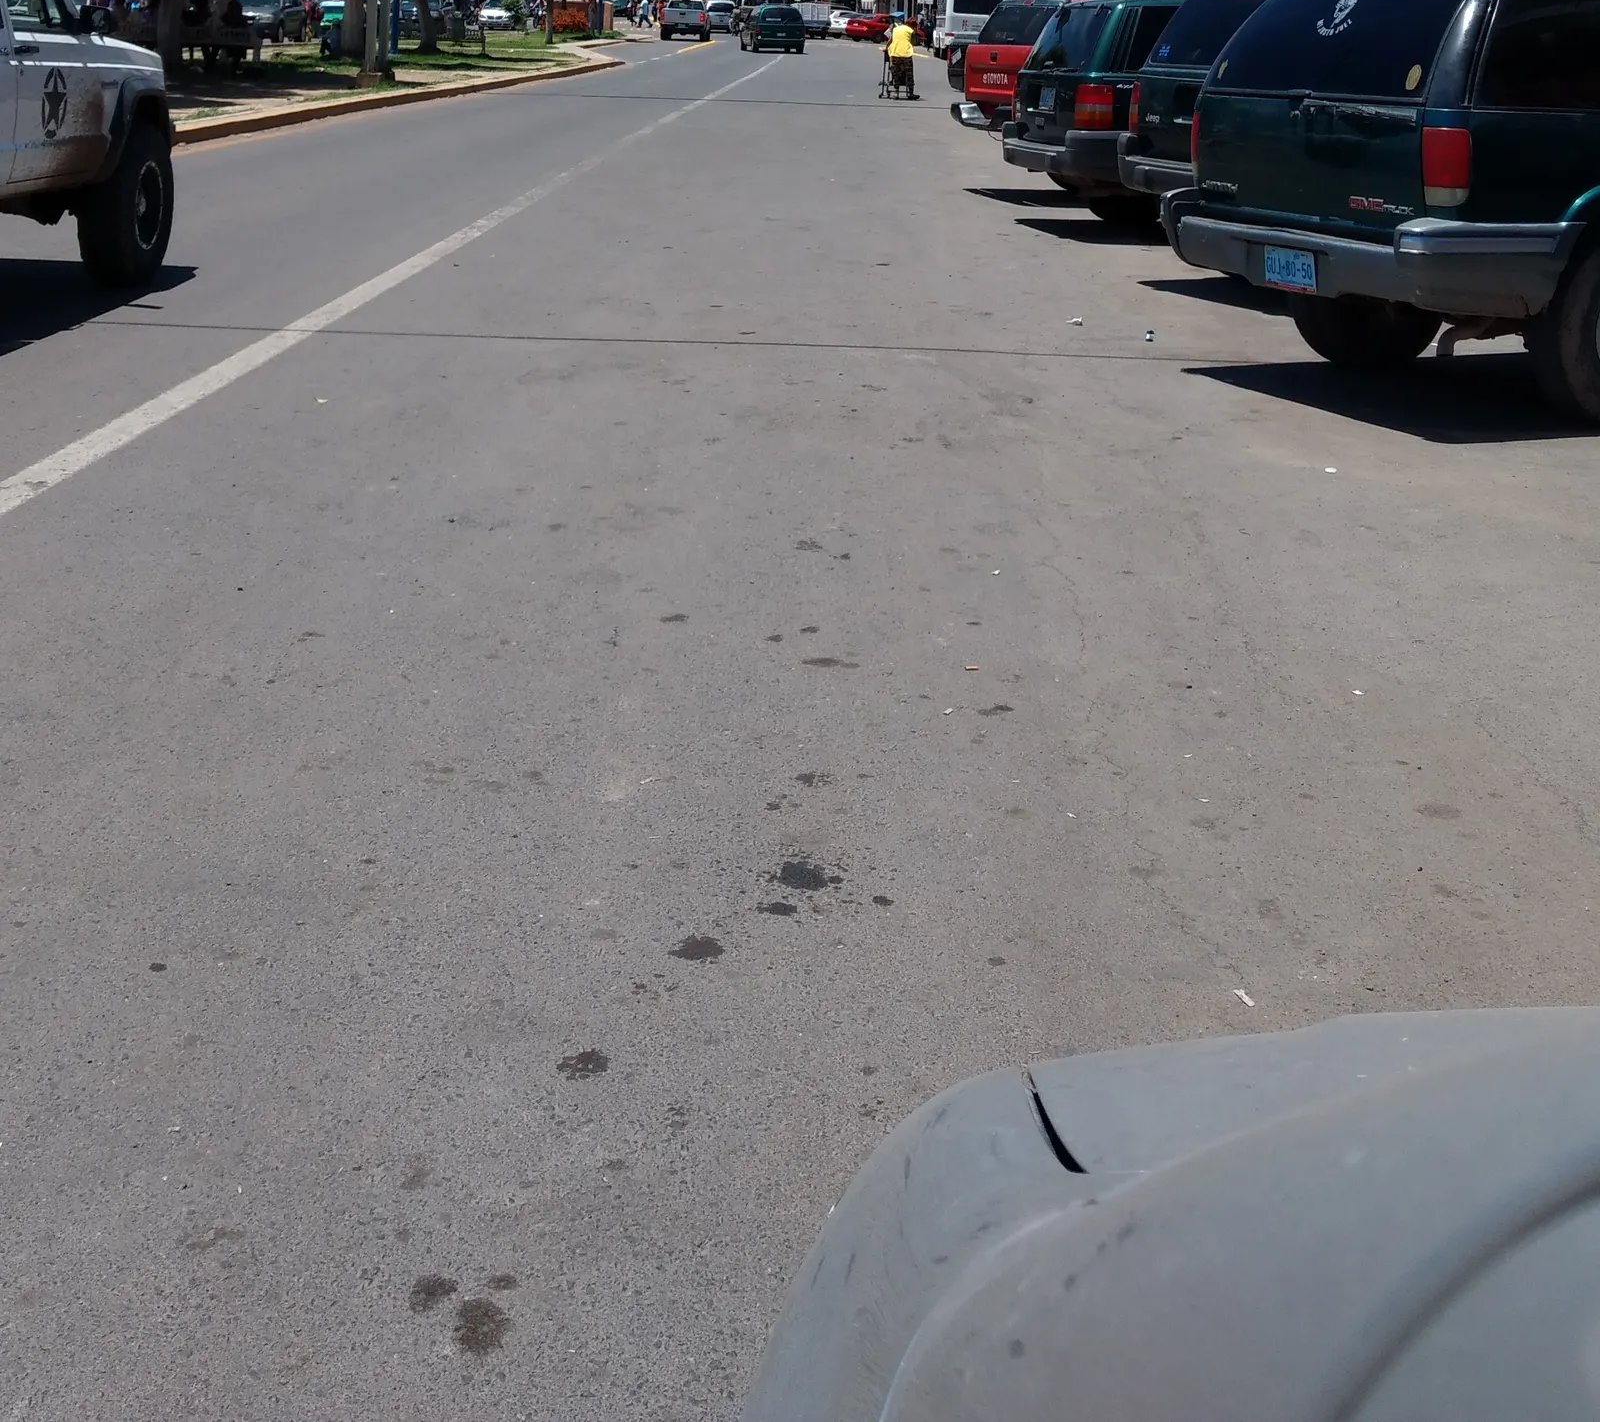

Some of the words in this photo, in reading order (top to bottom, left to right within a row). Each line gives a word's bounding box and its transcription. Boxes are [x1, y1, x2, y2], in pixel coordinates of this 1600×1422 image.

[987, 73, 1009, 85] TOYOTA
[1145, 112, 1160, 124] Jeep
[1349, 195, 1384, 212] GMC
